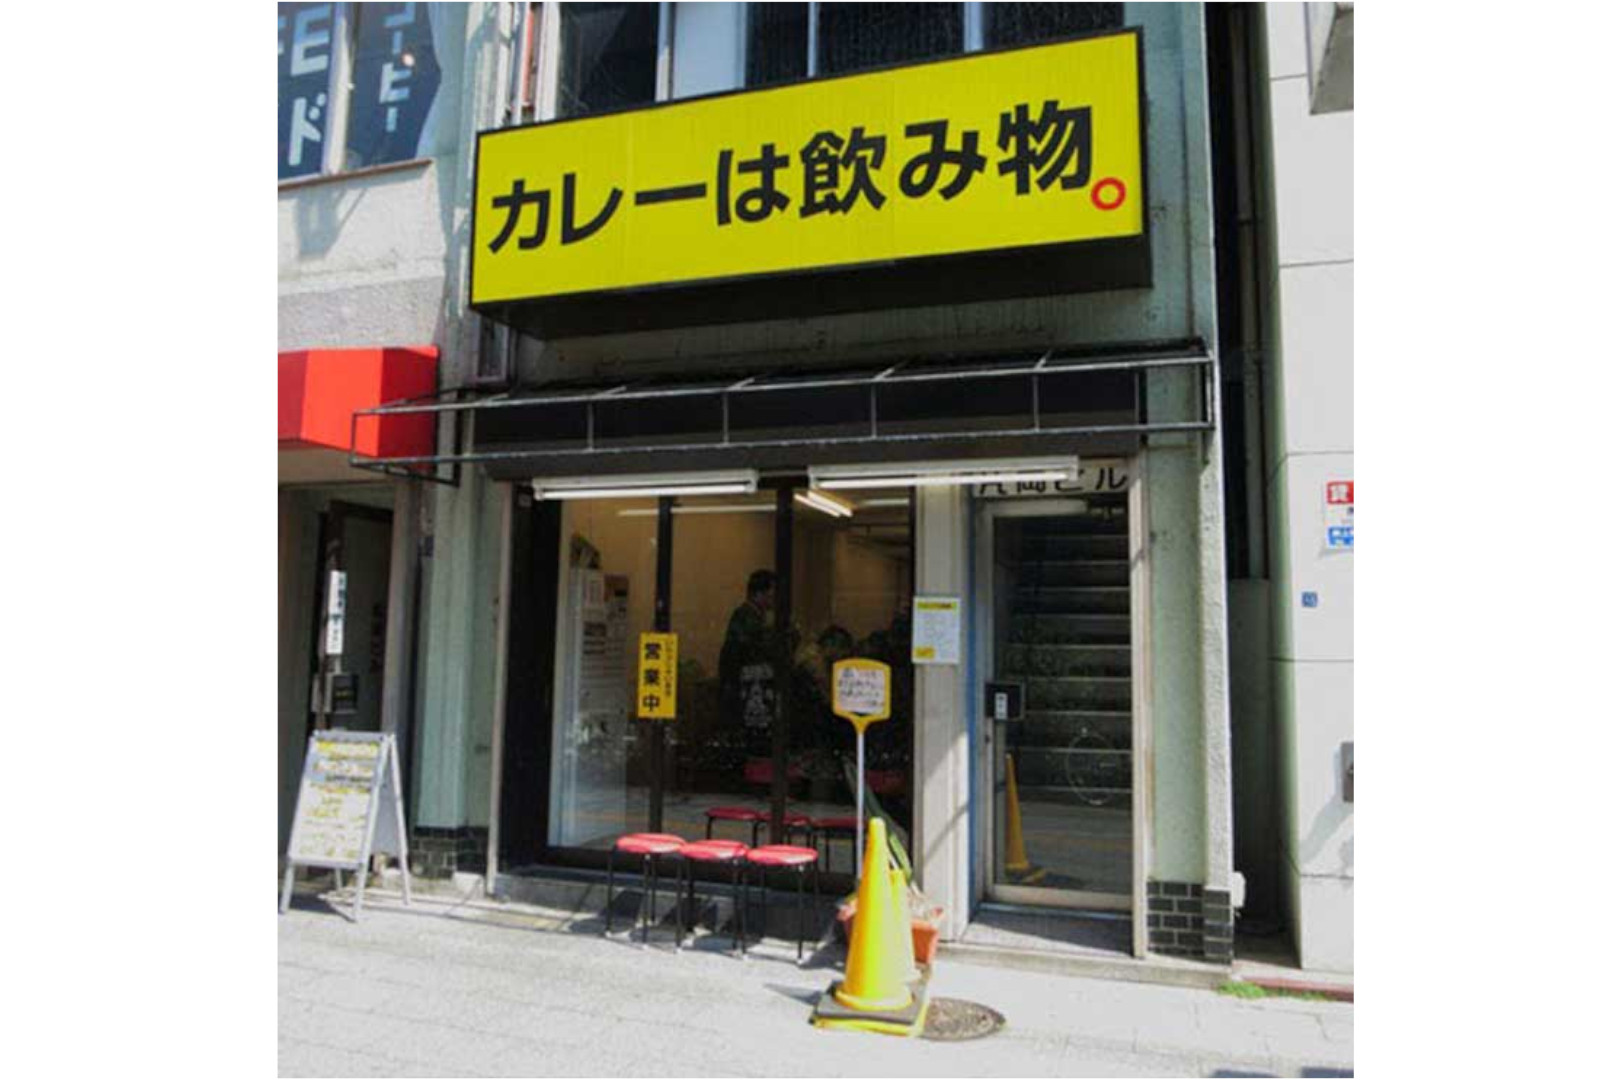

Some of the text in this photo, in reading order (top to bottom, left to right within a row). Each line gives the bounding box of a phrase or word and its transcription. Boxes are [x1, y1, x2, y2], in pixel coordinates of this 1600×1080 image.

[488, 100, 1127, 255] カレーは飲み物。
[642, 642, 662, 712] 営業中
